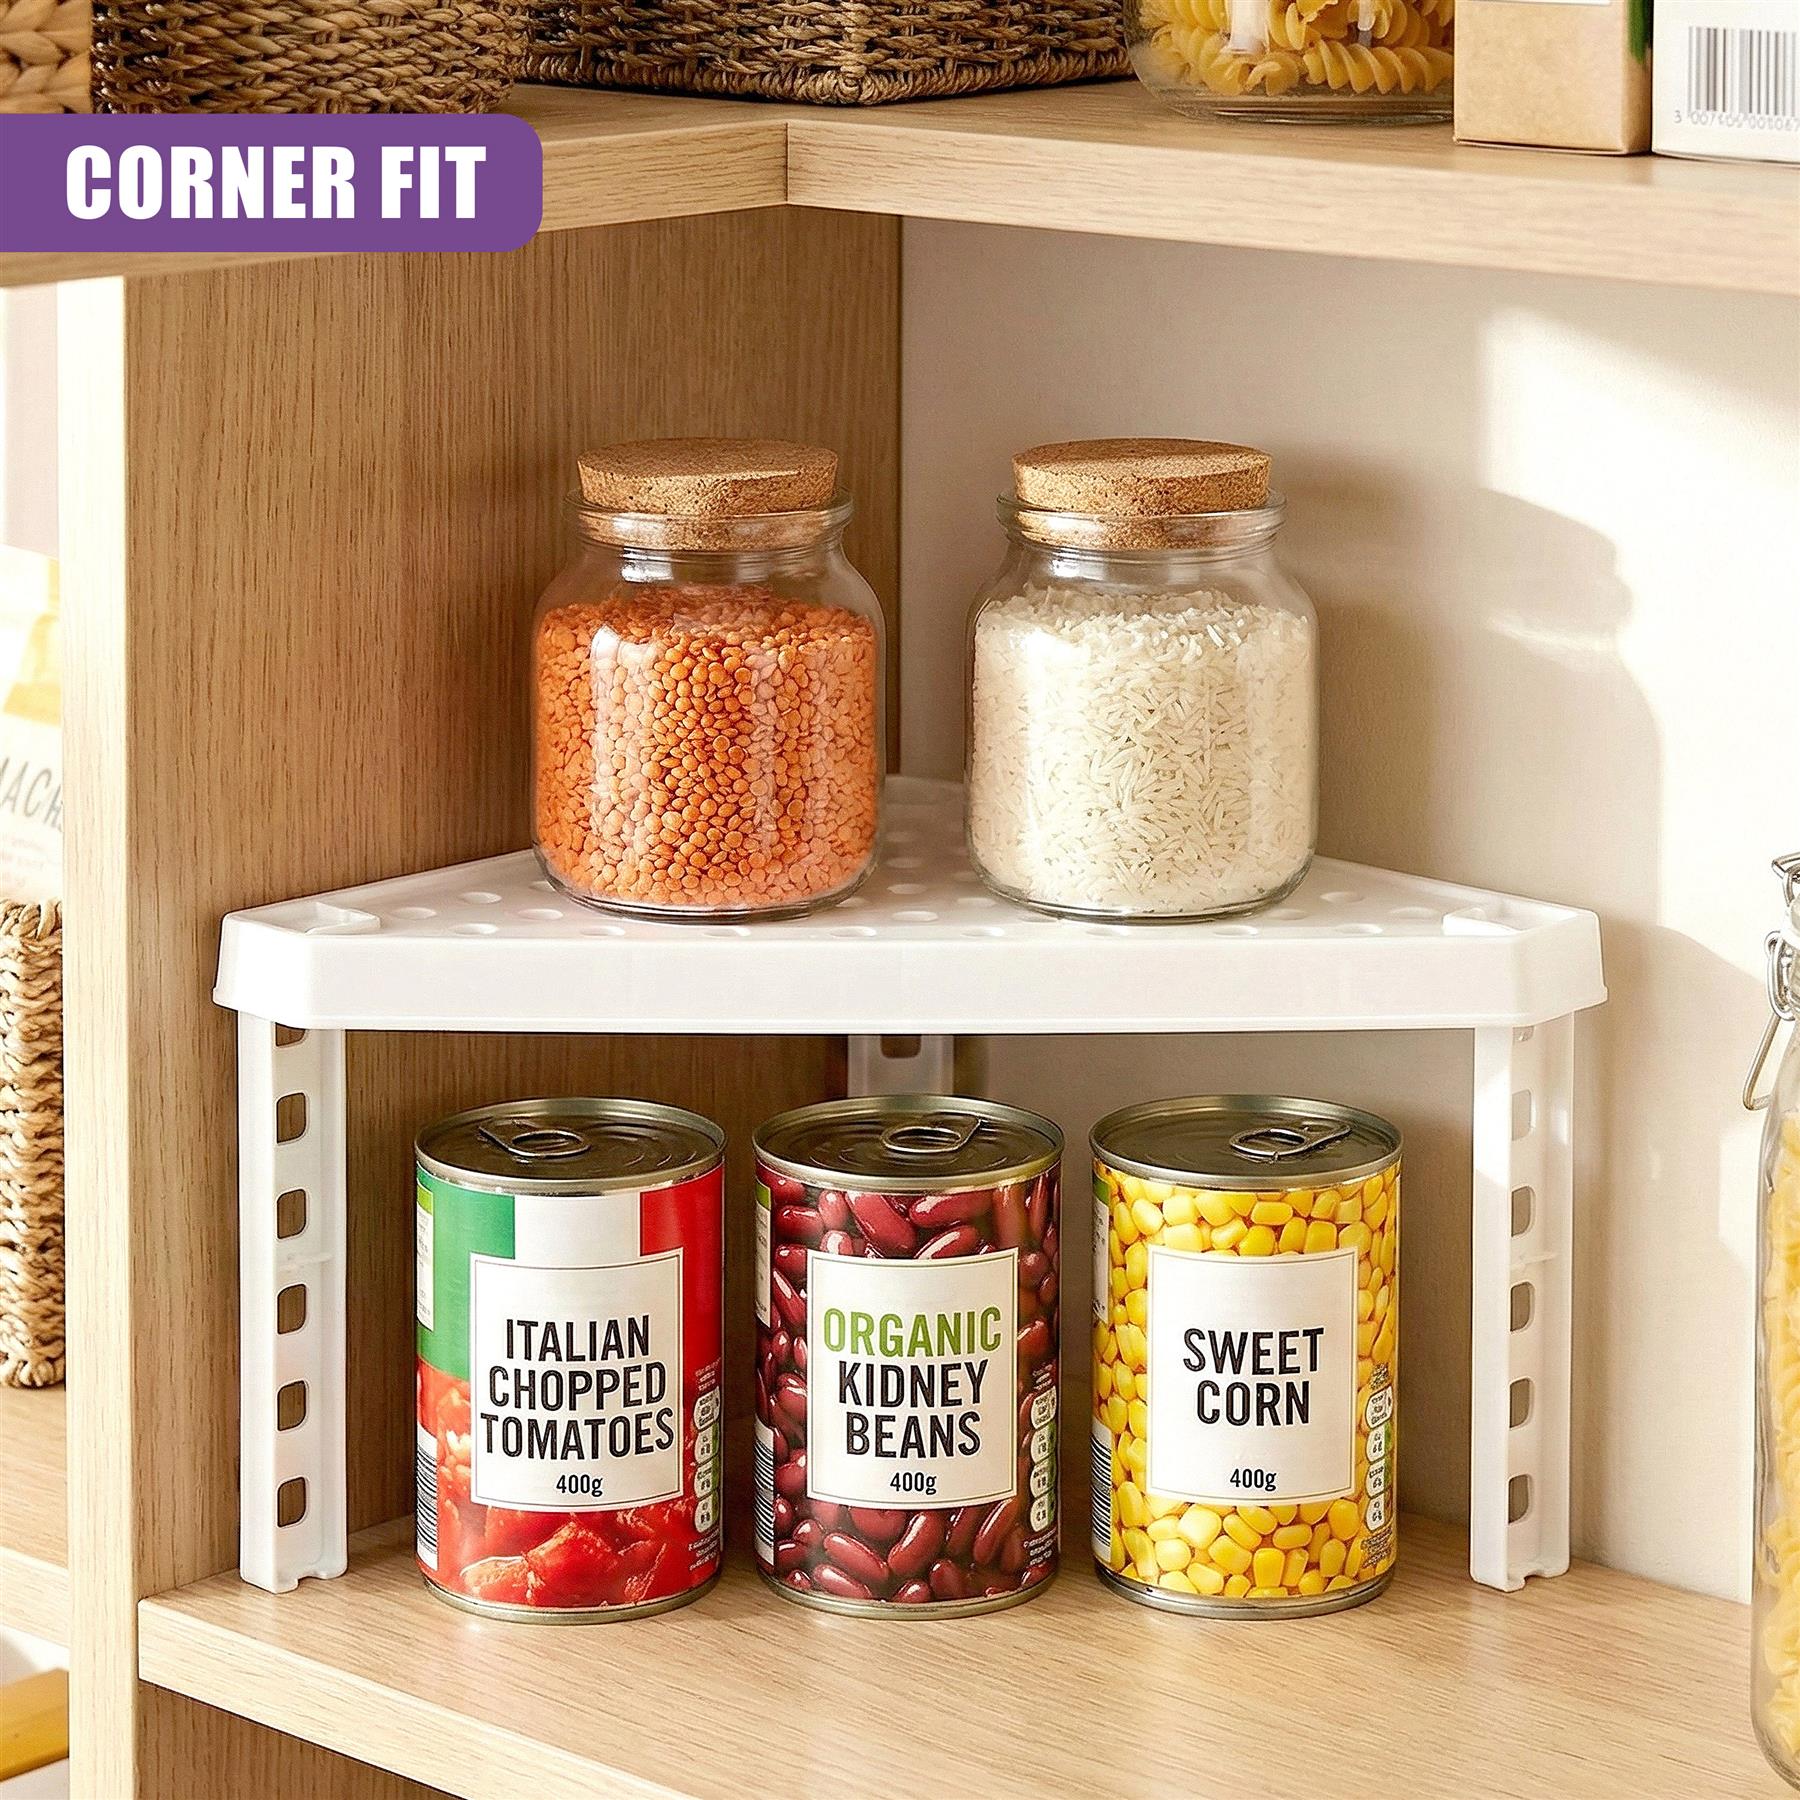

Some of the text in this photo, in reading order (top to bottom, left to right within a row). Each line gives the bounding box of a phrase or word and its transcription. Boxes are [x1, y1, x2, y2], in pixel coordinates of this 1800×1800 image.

[506, 1314, 650, 1363] ITALIAN
[823, 1306, 1002, 1358] ORGANIC
[1182, 1327, 1325, 1376] SWEET
[488, 1361, 666, 1412] CHOPPED
[838, 1359, 989, 1409] KIDNEY
[1196, 1379, 1310, 1427] CORN
[480, 1407, 675, 1461] TOMATOES
[846, 1410, 981, 1459] BEANS
[555, 1473, 604, 1498] 400g
[889, 1471, 938, 1496] 400g
[1229, 1468, 1277, 1492] 400g
